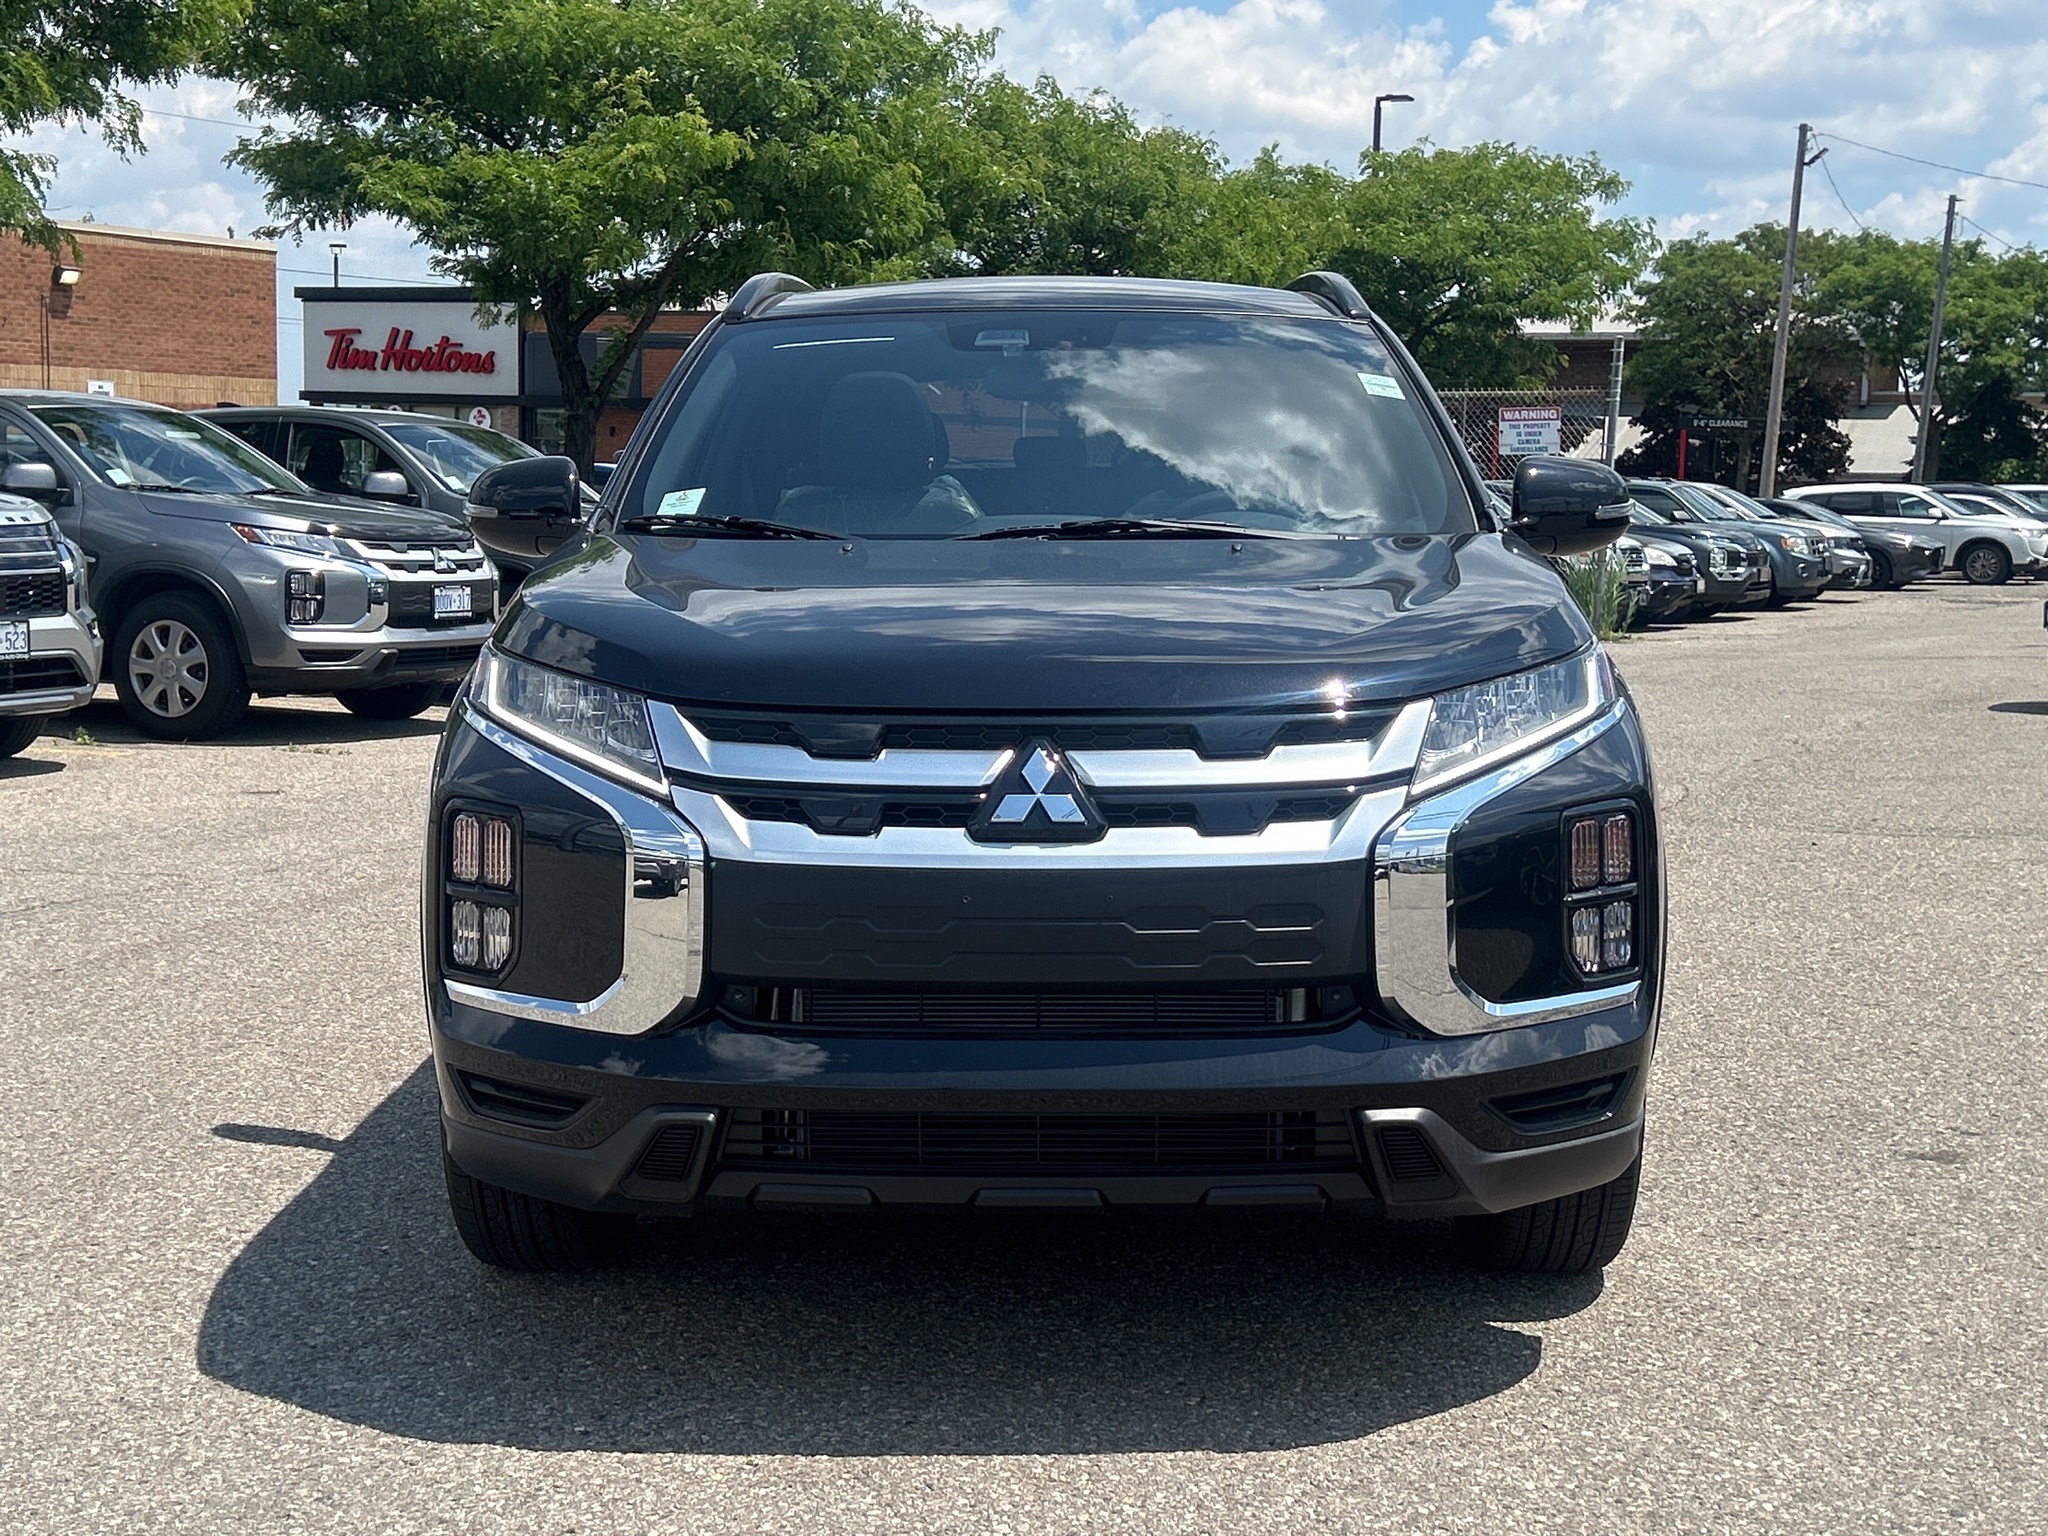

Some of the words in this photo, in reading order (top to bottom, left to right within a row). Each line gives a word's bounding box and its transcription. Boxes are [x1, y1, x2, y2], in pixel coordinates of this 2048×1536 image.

[324, 329, 378, 371] Tim
[380, 327, 496, 374] Hortons
[1503, 410, 1557, 420] WARNING
[1708, 420, 1748, 428] CLEARANCE
[5, 631, 26, 650] 523
